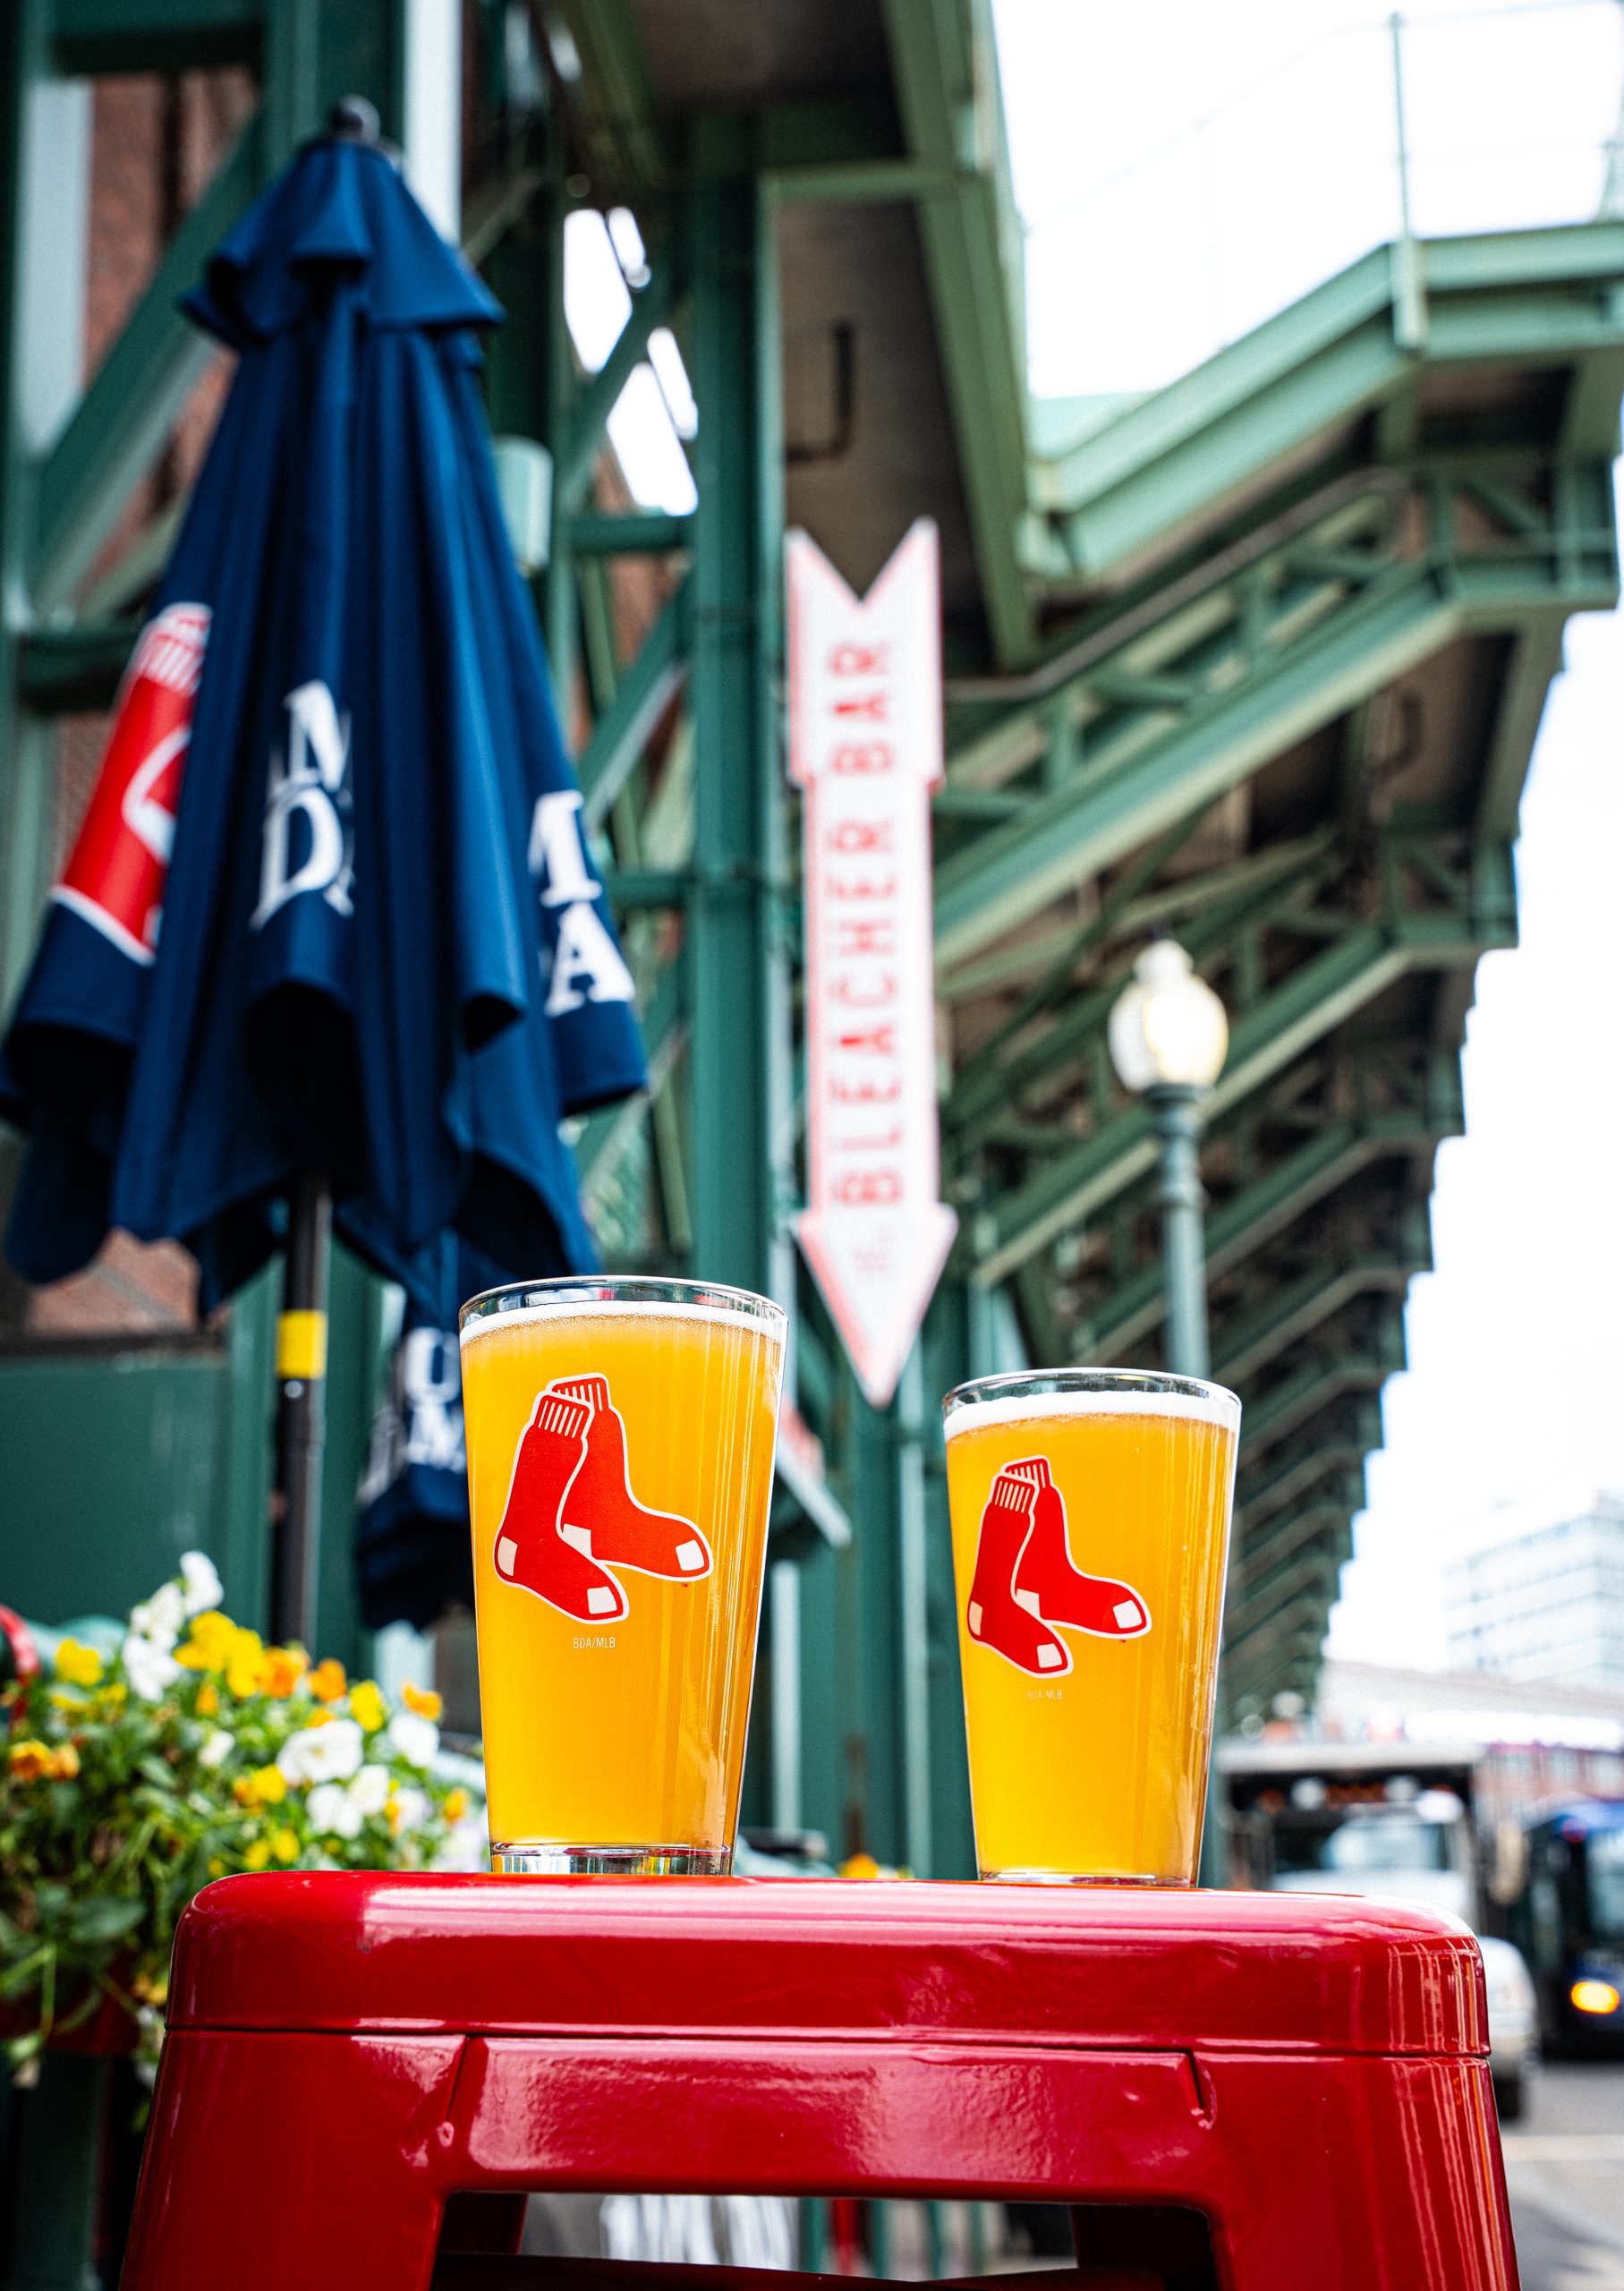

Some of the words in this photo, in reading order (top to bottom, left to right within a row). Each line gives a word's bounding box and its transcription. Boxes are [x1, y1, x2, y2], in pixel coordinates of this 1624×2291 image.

[831, 639, 893, 775] BAR
[830, 818, 902, 1205] BLEACHER
[573, 1637, 616, 1648] BDA/MLB
